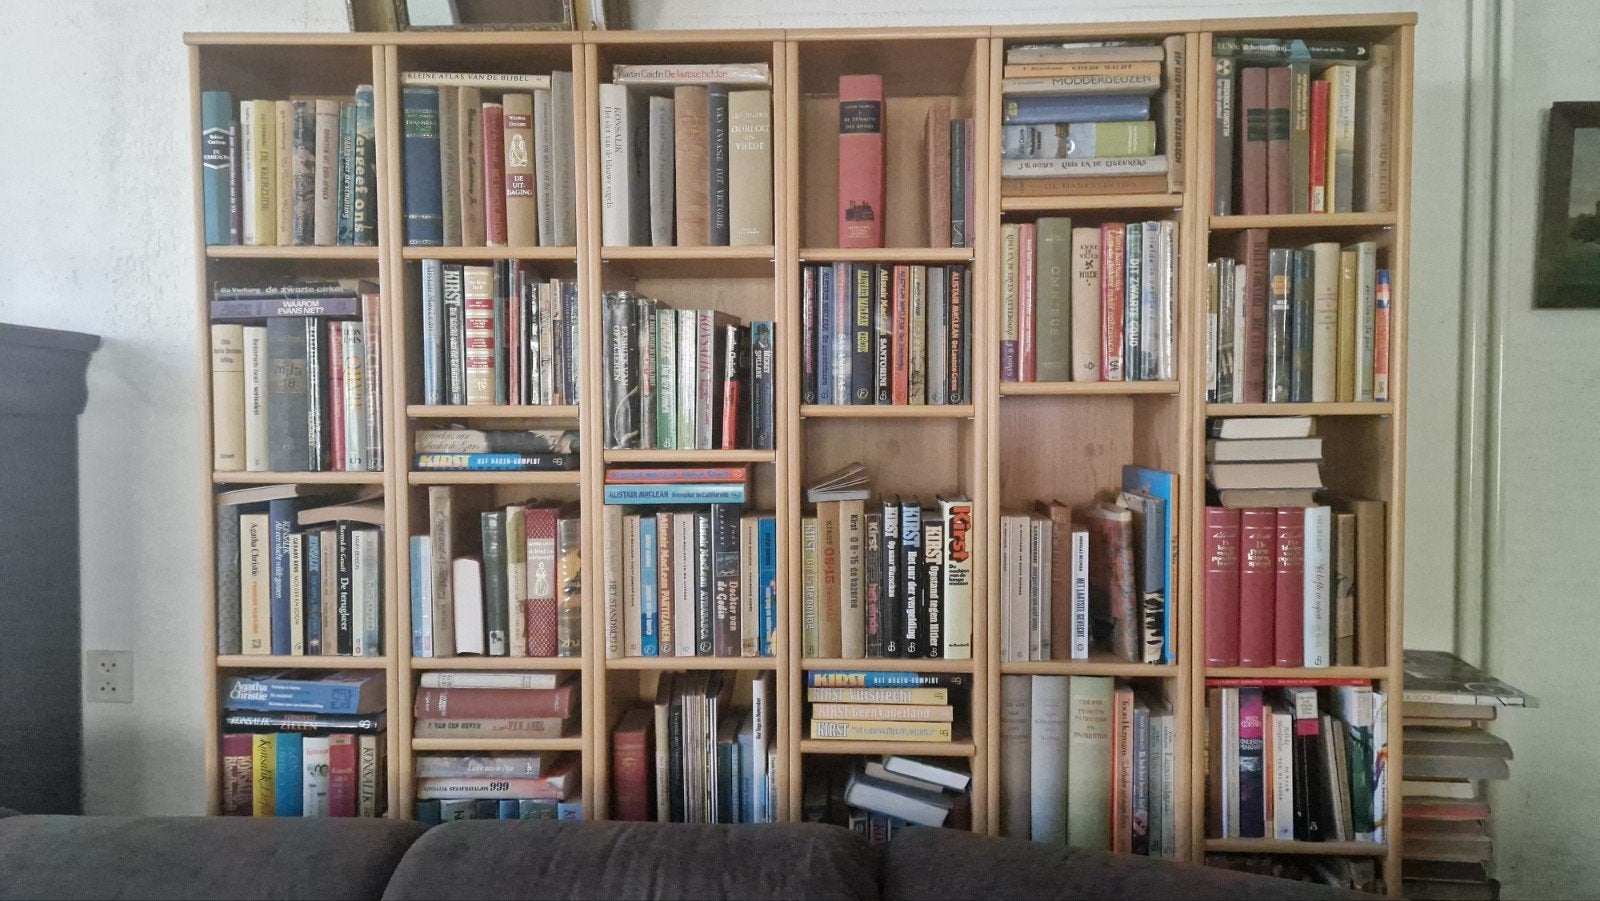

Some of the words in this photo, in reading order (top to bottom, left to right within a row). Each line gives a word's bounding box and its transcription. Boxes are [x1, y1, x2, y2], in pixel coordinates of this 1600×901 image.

[1053, 75, 1152, 88] MODDERGEUZEN
[1223, 79, 1231, 109] FREDERICK
[604, 106, 613, 118] Het
[717, 106, 725, 124] VAN
[1223, 110, 1232, 136] FORSYTH
[604, 121, 613, 132] slot
[614, 107, 622, 155] KONSALIK
[731, 125, 769, 134] OORLOG
[605, 150, 613, 159] de
[716, 128, 724, 162] INVASIE
[735, 142, 765, 151] VREDE
[344, 157, 352, 174] over
[354, 127, 372, 194] Vergeef
[605, 160, 613, 185] blauwe
[343, 175, 352, 185] de
[716, 166, 724, 183] TOT
[342, 186, 352, 219] schutting
[506, 188, 533, 197] DAGING
[604, 186, 613, 208] vogels
[354, 198, 369, 234] ons
[716, 189, 725, 229] VICTORIE
[1114, 228, 1122, 250] Toon
[1079, 270, 1098, 278] HILDE
[1129, 258, 1139, 274] DIT
[265, 285, 278, 293] de
[280, 285, 316, 293] zwarte
[317, 285, 343, 293] cirkel
[444, 269, 461, 306] KIRST
[857, 269, 869, 297] ALISTAIR
[879, 269, 888, 300] Alistair
[951, 271, 960, 304] ALISTAIR
[283, 300, 320, 308] WAAROM
[1051, 265, 1061, 336] OMNIBUS
[1128, 276, 1140, 318] ZWARTE
[277, 307, 302, 316] EVANS
[303, 306, 324, 315] NIET?
[857, 298, 869, 326] MACLEAN
[621, 325, 629, 366] FABRIEK
[699, 314, 712, 374] KONSALIK
[857, 331, 869, 353] CIRCUS
[951, 341, 958, 349] De
[1128, 319, 1139, 348] GOUD
[613, 325, 621, 382] OFFICIEREN
[754, 350, 762, 379] SPILLANE
[763, 350, 771, 374] MICKEY
[879, 338, 888, 387] SANTORINI
[283, 378, 296, 389] 18
[621, 367, 629, 386] VAN
[837, 352, 847, 392] ANDREAS
[419, 455, 471, 469] KIRST
[608, 490, 638, 499] ALISTAIR
[274, 520, 283, 531] Als
[339, 524, 347, 545] Barend
[660, 517, 669, 548] Alistair
[699, 517, 709, 547] Alistair
[850, 514, 859, 532] Kirst
[884, 506, 899, 539] KIRST
[902, 506, 921, 548] KIRST
[949, 505, 972, 563] Kirst
[249, 522, 258, 548] Agatha
[274, 531, 282, 542] een
[282, 520, 291, 556] KONSALIK
[805, 524, 817, 552] KIRST
[868, 522, 879, 552] Kirst
[887, 541, 896, 549] Op
[925, 526, 943, 565] KIRST
[250, 548, 259, 577] Christie
[309, 535, 319, 572] KONSALIK
[907, 551, 918, 565] Het
[660, 549, 669, 589] MacLean
[699, 548, 709, 588] MacLean
[850, 567, 859, 577] de
[907, 566, 915, 580] uur
[340, 577, 349, 589] De
[609, 581, 617, 596] HET
[717, 581, 726, 591] de
[806, 586, 816, 599] De
[850, 578, 859, 609] kazerne
[888, 566, 897, 598] Warschau
[907, 581, 918, 595] der
[928, 566, 939, 599] Opstand
[1076, 577, 1085, 589] HET
[294, 598, 300, 606] EN
[716, 593, 727, 619] Godin
[729, 580, 739, 614] Dochter
[1076, 589, 1085, 613] LAATSTE
[338, 591, 349, 631] terugkeer
[660, 590, 671, 642] PARTIZANEN
[729, 615, 738, 631] van
[805, 599, 816, 630] oorlog
[906, 596, 918, 640] vergelding
[928, 600, 938, 623] tegen
[609, 598, 617, 653] STANDBEELD
[929, 623, 940, 647] Hitler
[1076, 613, 1085, 638] GEVECHT
[233, 680, 268, 693] Agatha
[814, 673, 867, 688] KIRST
[229, 690, 268, 702] Christie
[813, 688, 845, 702] KIRST
[848, 689, 914, 704] Vuistrecht
[818, 705, 850, 719] KIRST
[852, 706, 877, 718] Geen
[878, 707, 930, 720] Vaderland
[1121, 700, 1131, 720] Toon
[817, 723, 849, 739] KIRST
[1121, 720, 1131, 757] Hermans
[257, 739, 273, 782] Konsalik
[361, 747, 376, 804] KONSALIK
[489, 780, 510, 791] 999
